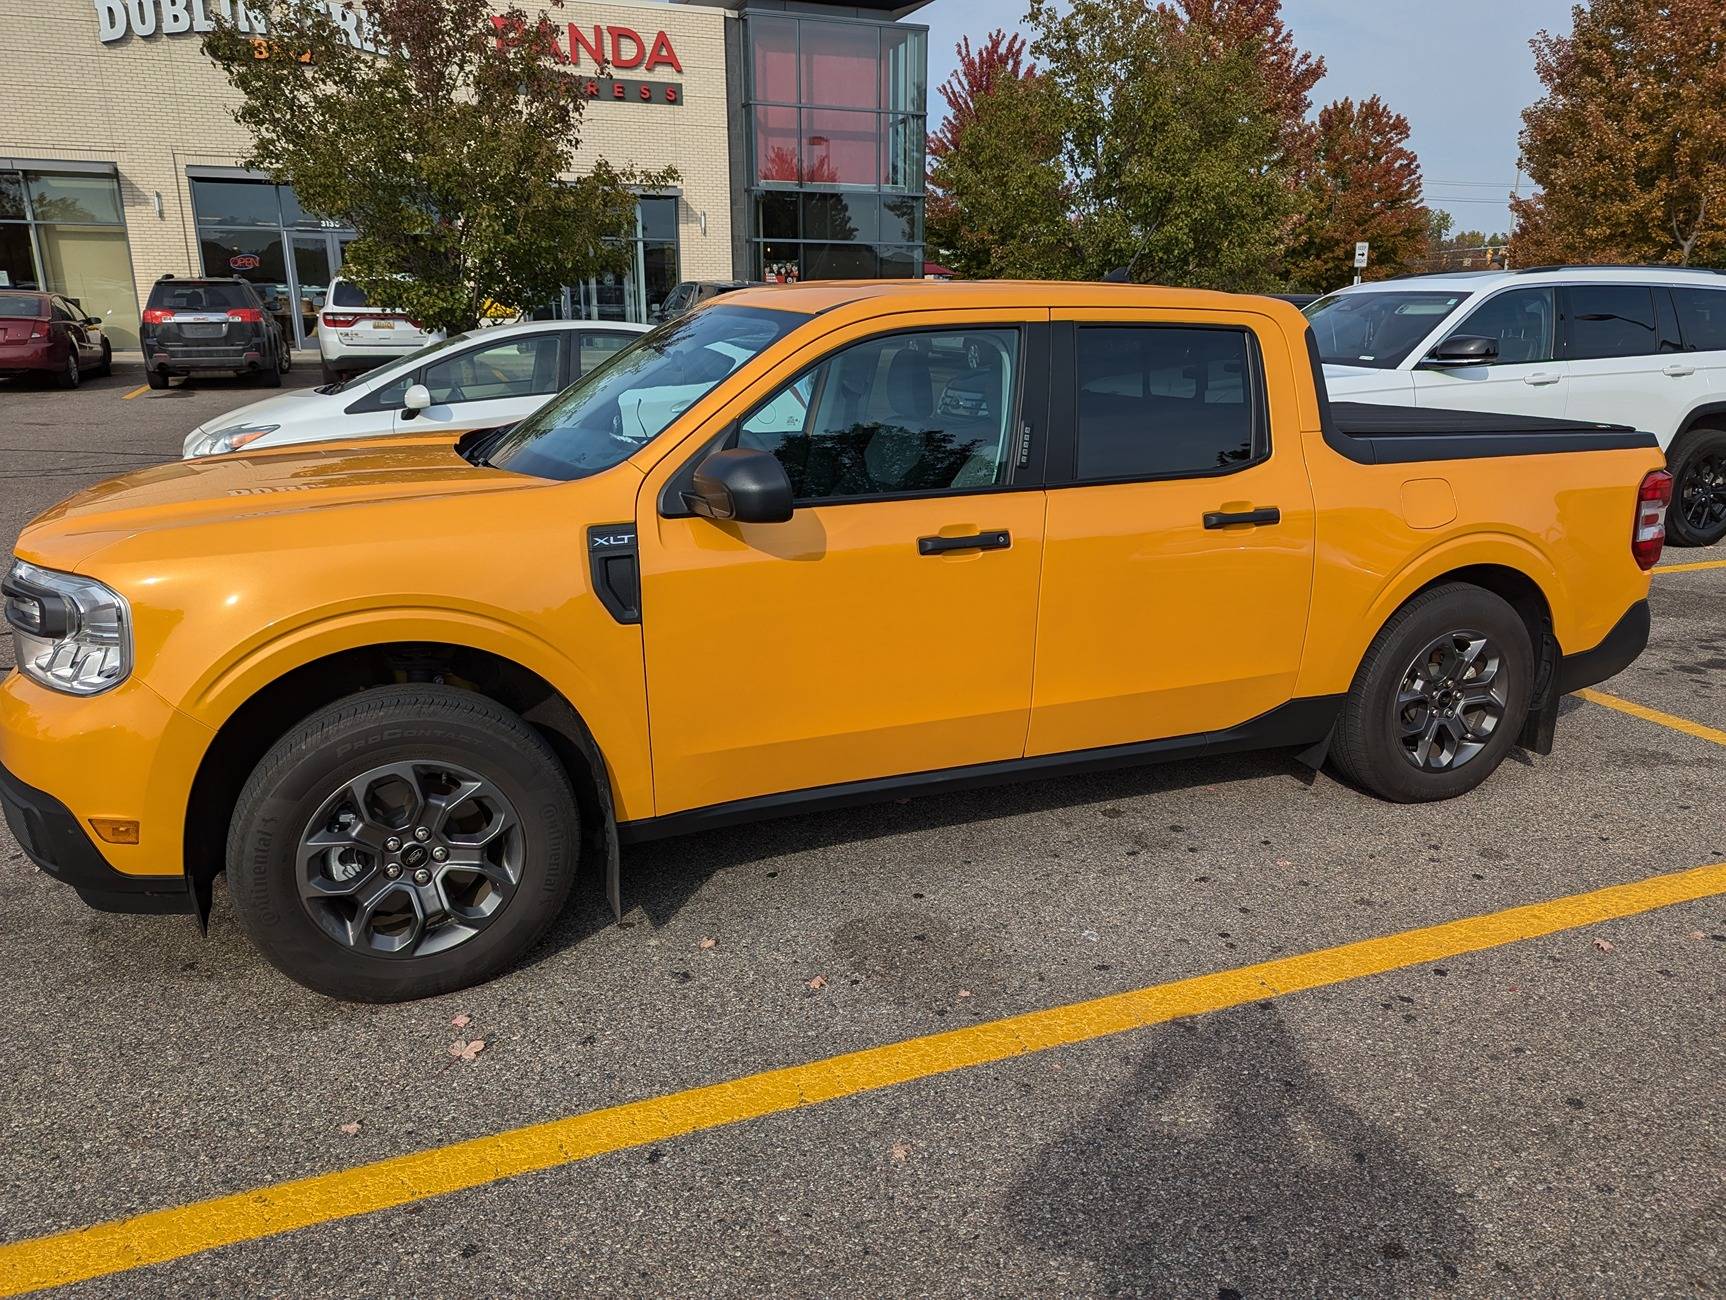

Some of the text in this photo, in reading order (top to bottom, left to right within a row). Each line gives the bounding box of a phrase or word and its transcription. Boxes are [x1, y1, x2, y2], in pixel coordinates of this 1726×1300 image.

[94, 0, 267, 42] DUBLIN
[230, 255, 260, 268] OPEN
[592, 534, 636, 547] XLT
